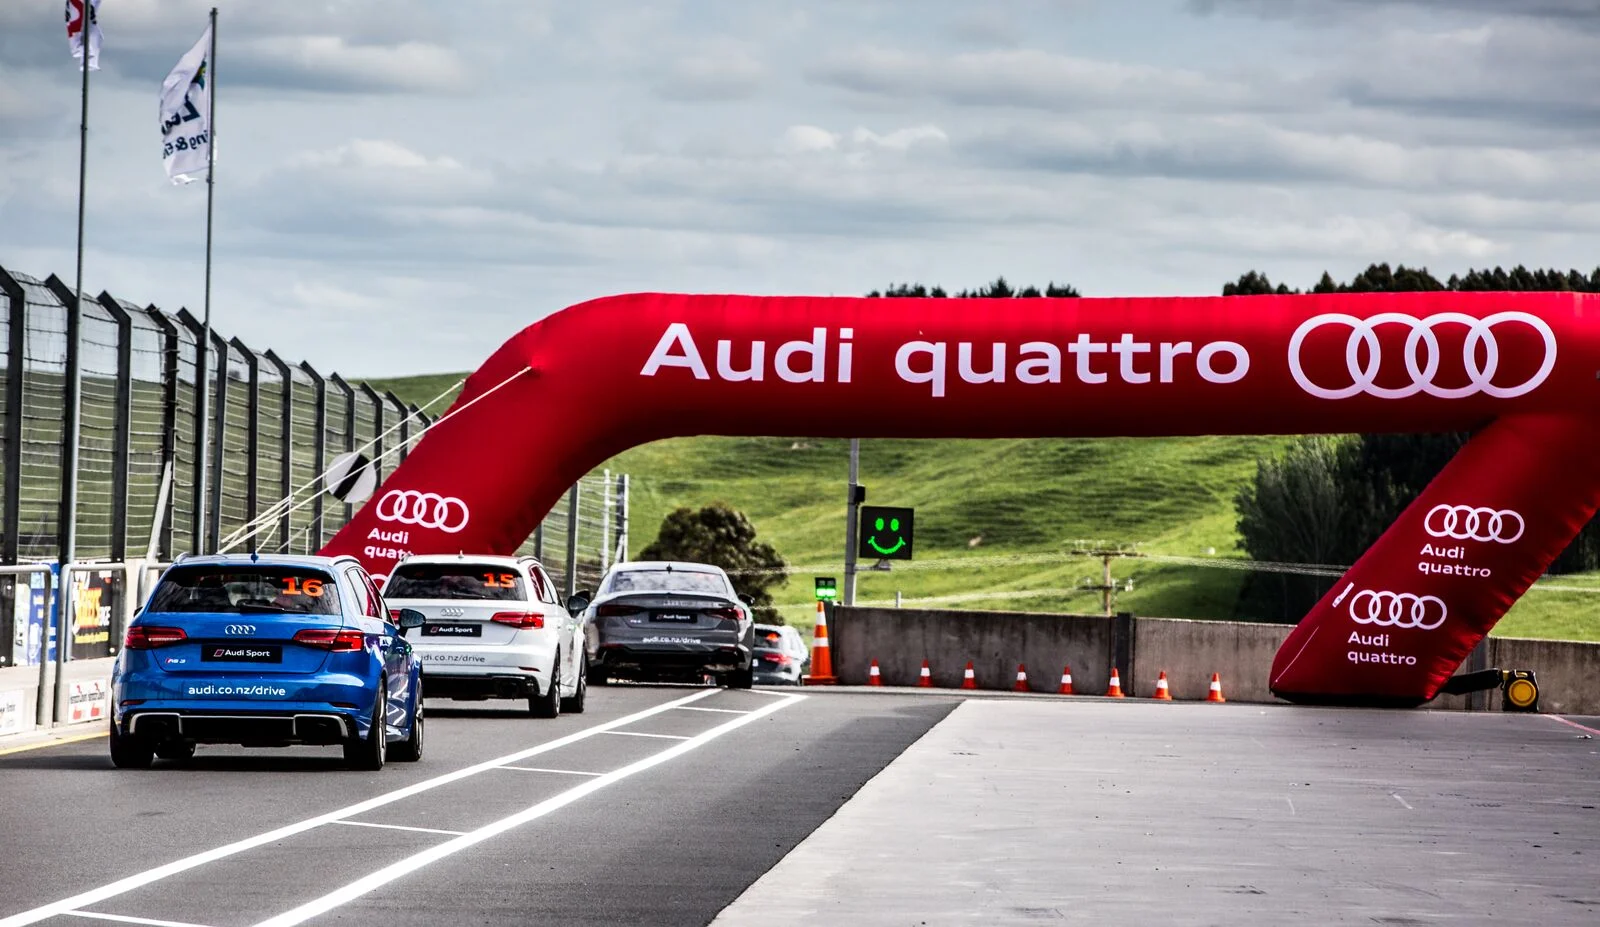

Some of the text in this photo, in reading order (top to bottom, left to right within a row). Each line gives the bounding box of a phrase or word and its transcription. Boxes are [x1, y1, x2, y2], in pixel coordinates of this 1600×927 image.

[640, 322, 1250, 397] Audi quattro
[367, 527, 409, 544] Audi
[364, 545, 415, 559] quat
[1420, 543, 1465, 559] Audi
[1418, 561, 1491, 578] quattro
[282, 577, 323, 597] 16
[483, 573, 515, 588] 15
[642, 636, 701, 644] audi.co.nz/drive
[1347, 631, 1389, 647] Audi
[246, 649, 271, 658] Sport
[421, 653, 486, 663] di.co.nz/drive
[1347, 650, 1417, 665] quattro
[188, 685, 286, 696] audi.co.nz/drive
